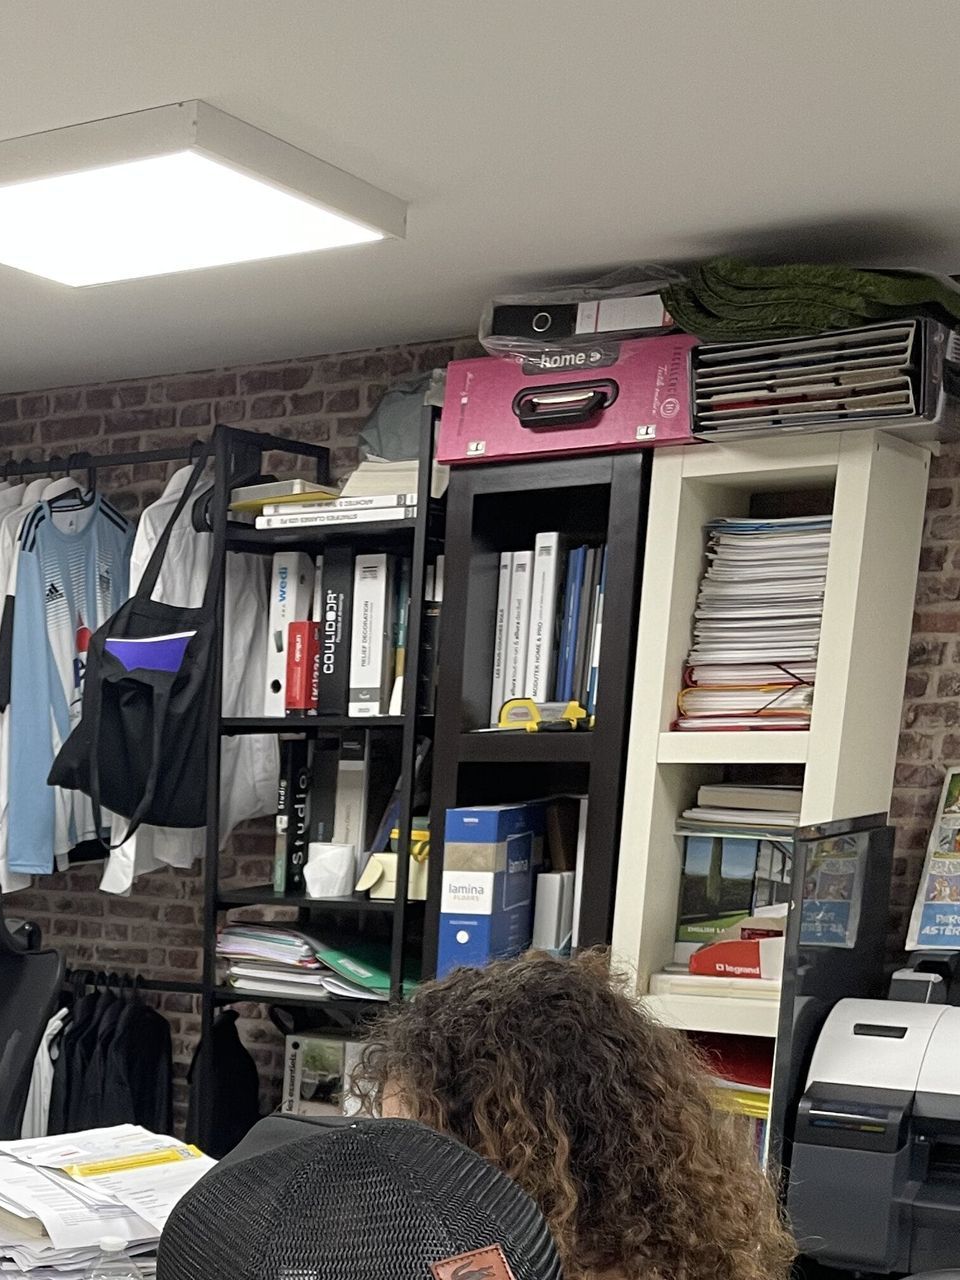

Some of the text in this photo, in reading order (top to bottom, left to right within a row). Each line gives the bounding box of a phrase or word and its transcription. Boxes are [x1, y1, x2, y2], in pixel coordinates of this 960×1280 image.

[540, 352, 586, 368] home
[278, 567, 288, 602] wedi
[278, 780, 287, 810] Studio
[292, 775, 308, 865] Studio
[448, 883, 485, 895] lamina
[725, 964, 760, 975] legrand
